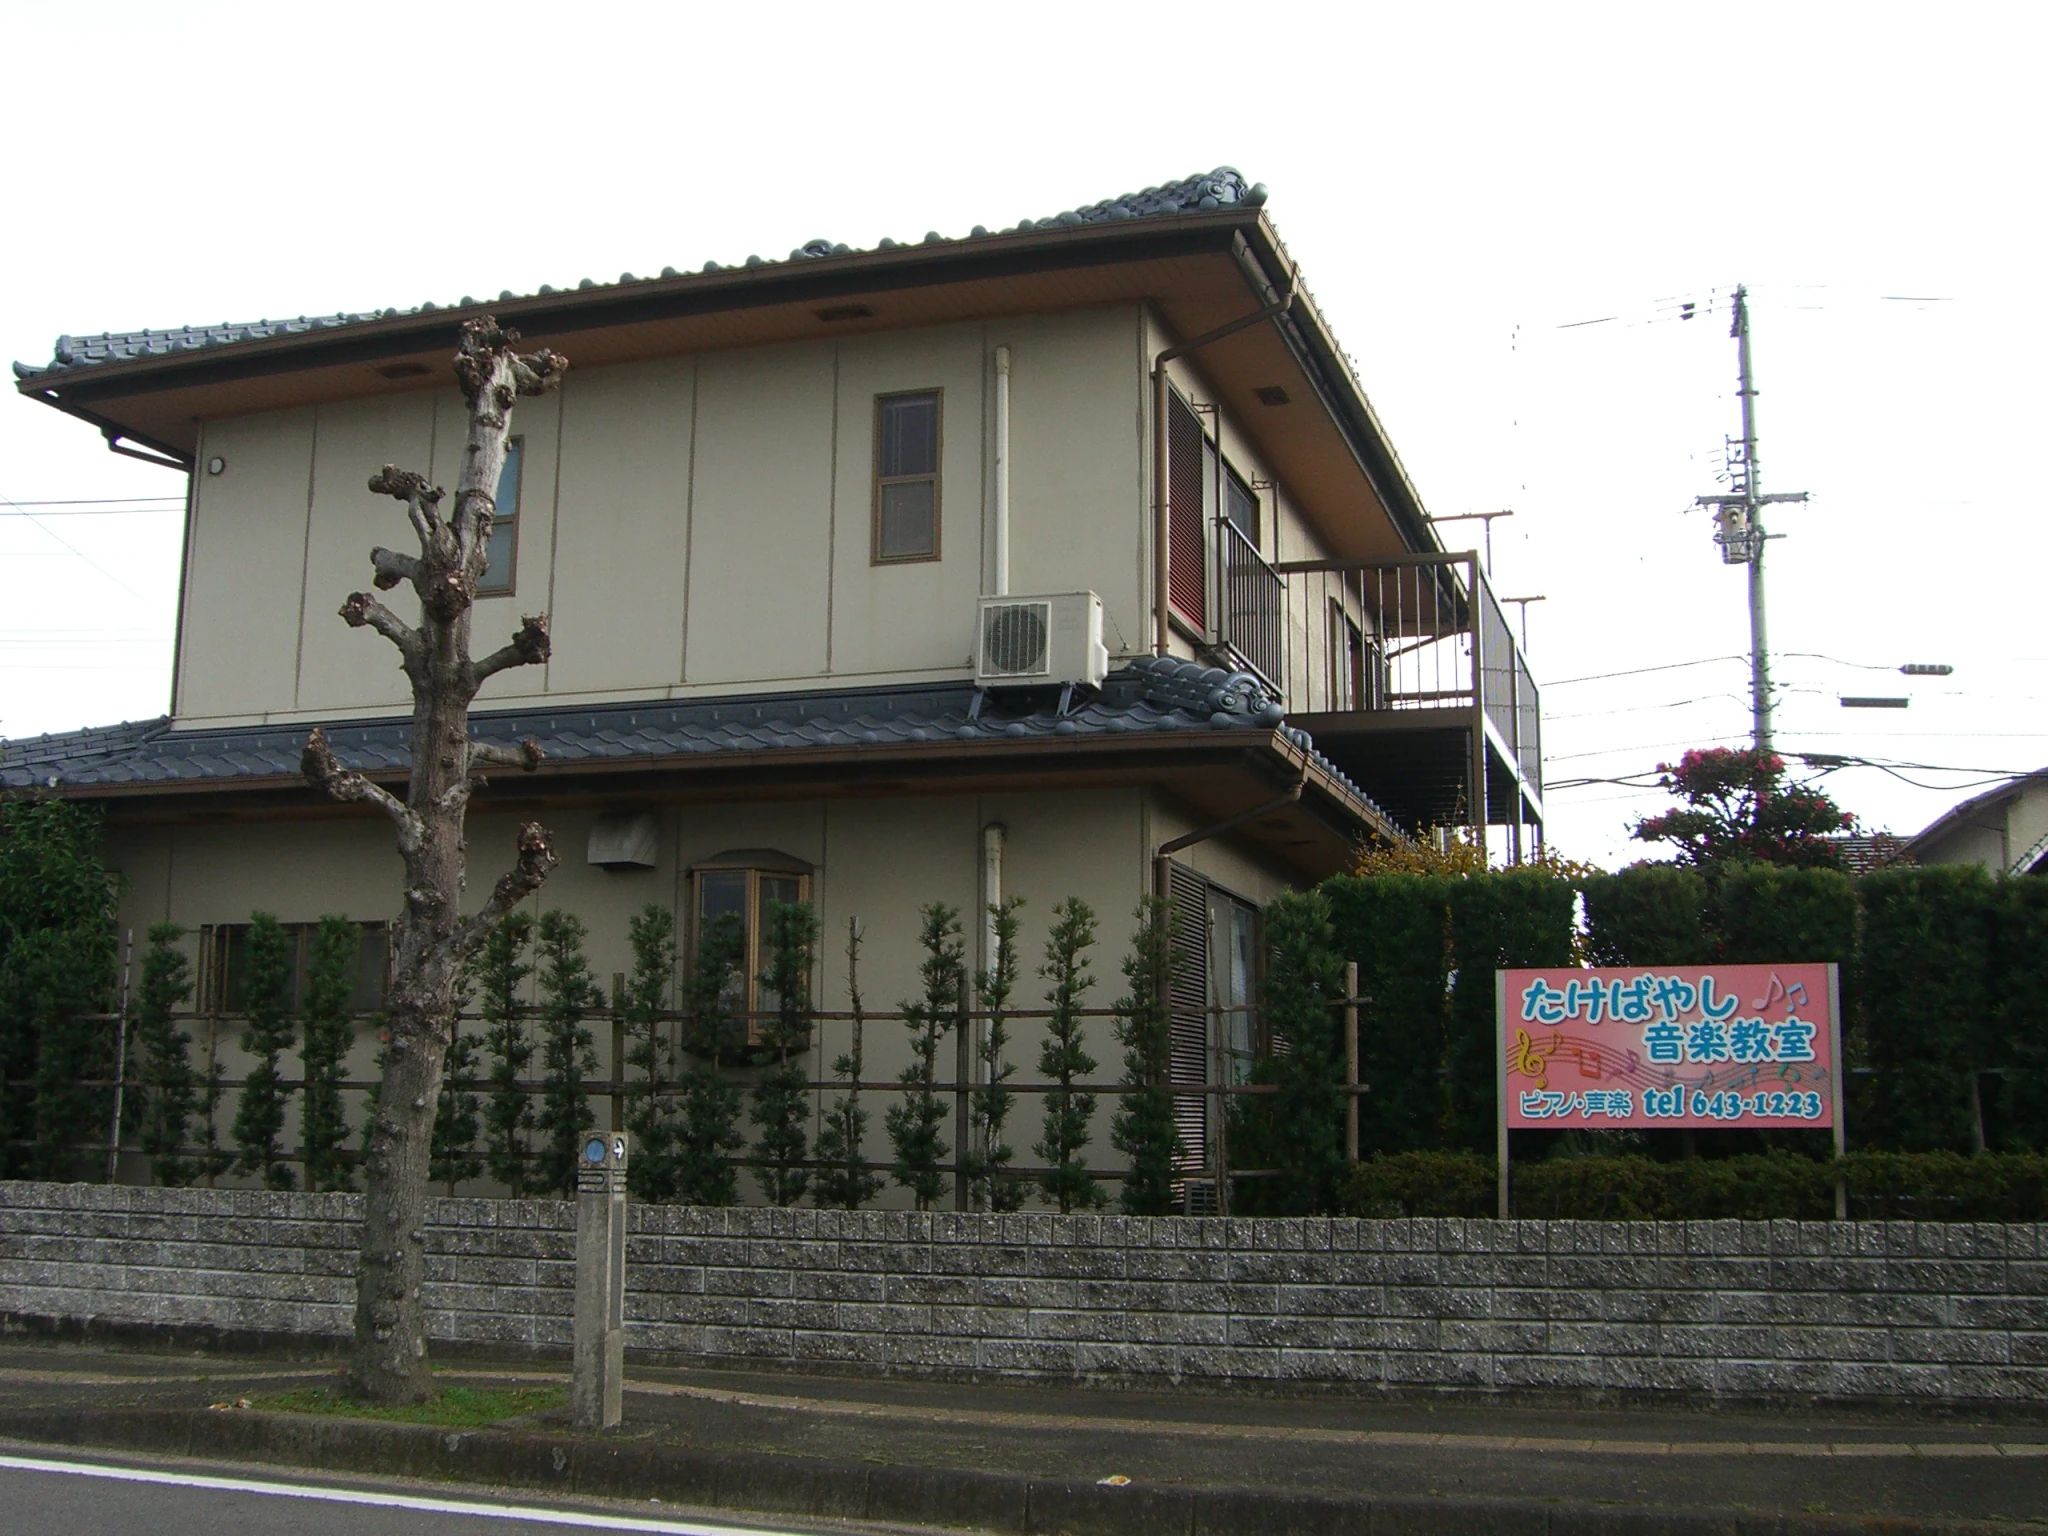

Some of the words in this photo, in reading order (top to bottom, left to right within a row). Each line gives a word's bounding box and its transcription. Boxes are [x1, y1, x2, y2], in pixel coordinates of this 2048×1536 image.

[1523, 973, 1738, 1024] たけばやし
[1643, 1018, 1816, 1064] 音楽教室
[1519, 1090, 1633, 1118] ピアノ・声楽
[1643, 1084, 1686, 1117] tel
[1690, 1092, 1822, 1120] 643-1223
